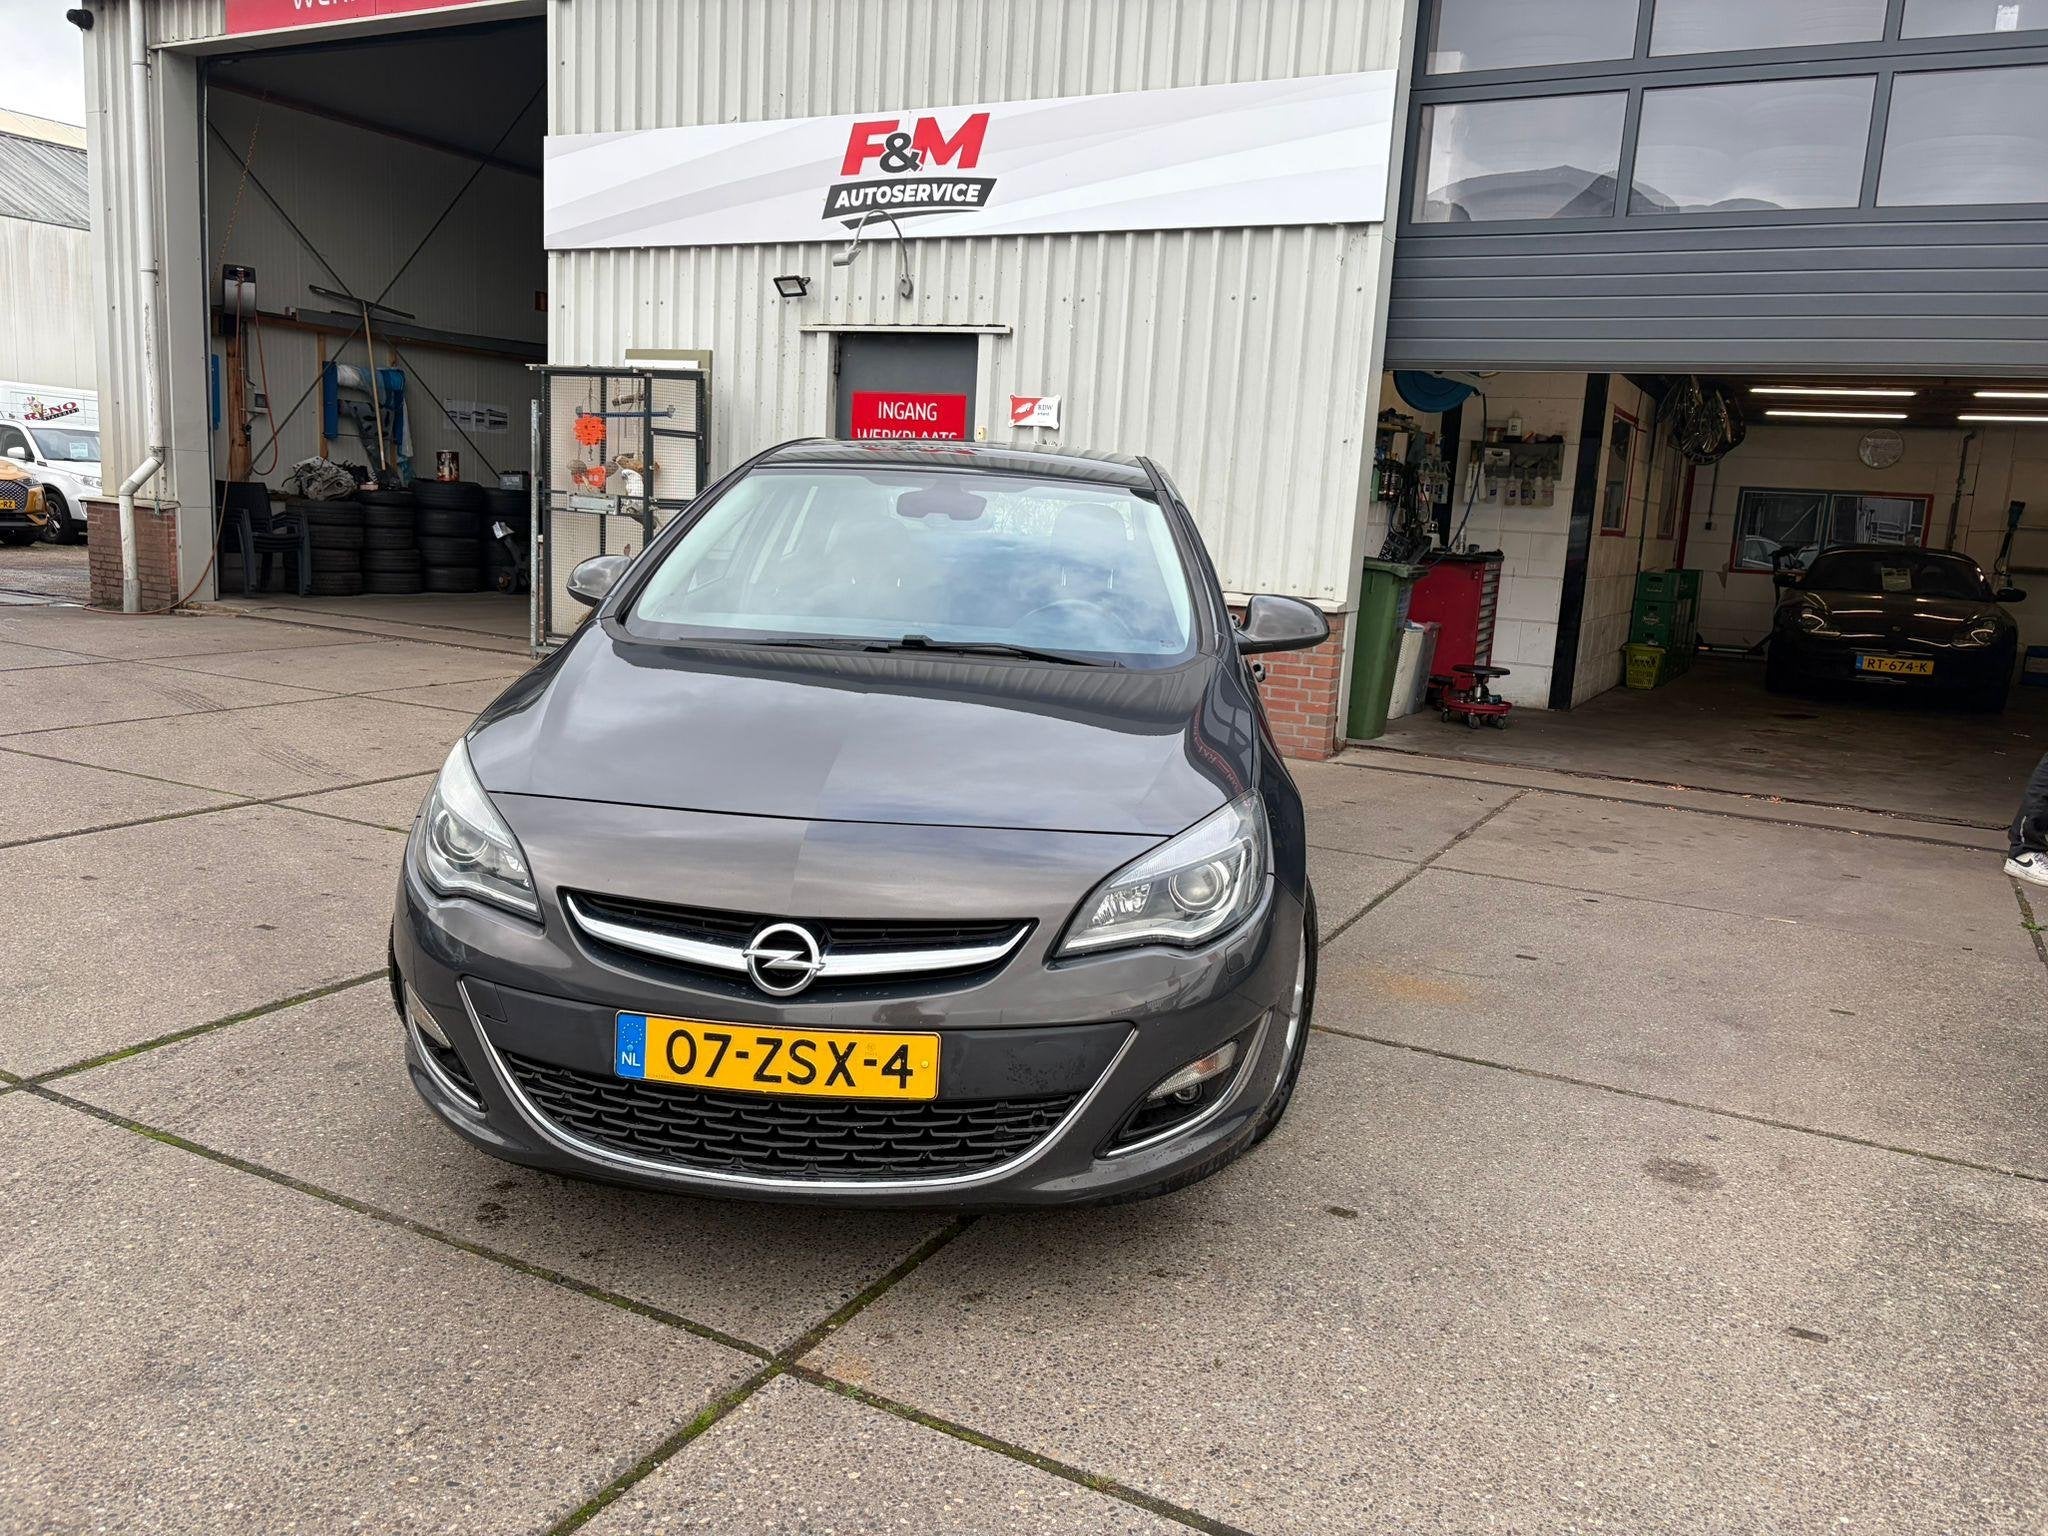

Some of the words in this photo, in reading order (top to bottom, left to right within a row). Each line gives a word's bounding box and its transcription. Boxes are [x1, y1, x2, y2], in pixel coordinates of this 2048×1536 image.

[840, 112, 991, 176] F&M
[834, 183, 982, 209] AUTOSERVICE
[878, 401, 938, 421] INGANG
[1867, 658, 1928, 673] RT-674-K
[621, 1051, 641, 1067] NL
[666, 1029, 913, 1089] 07-ZSX-4
